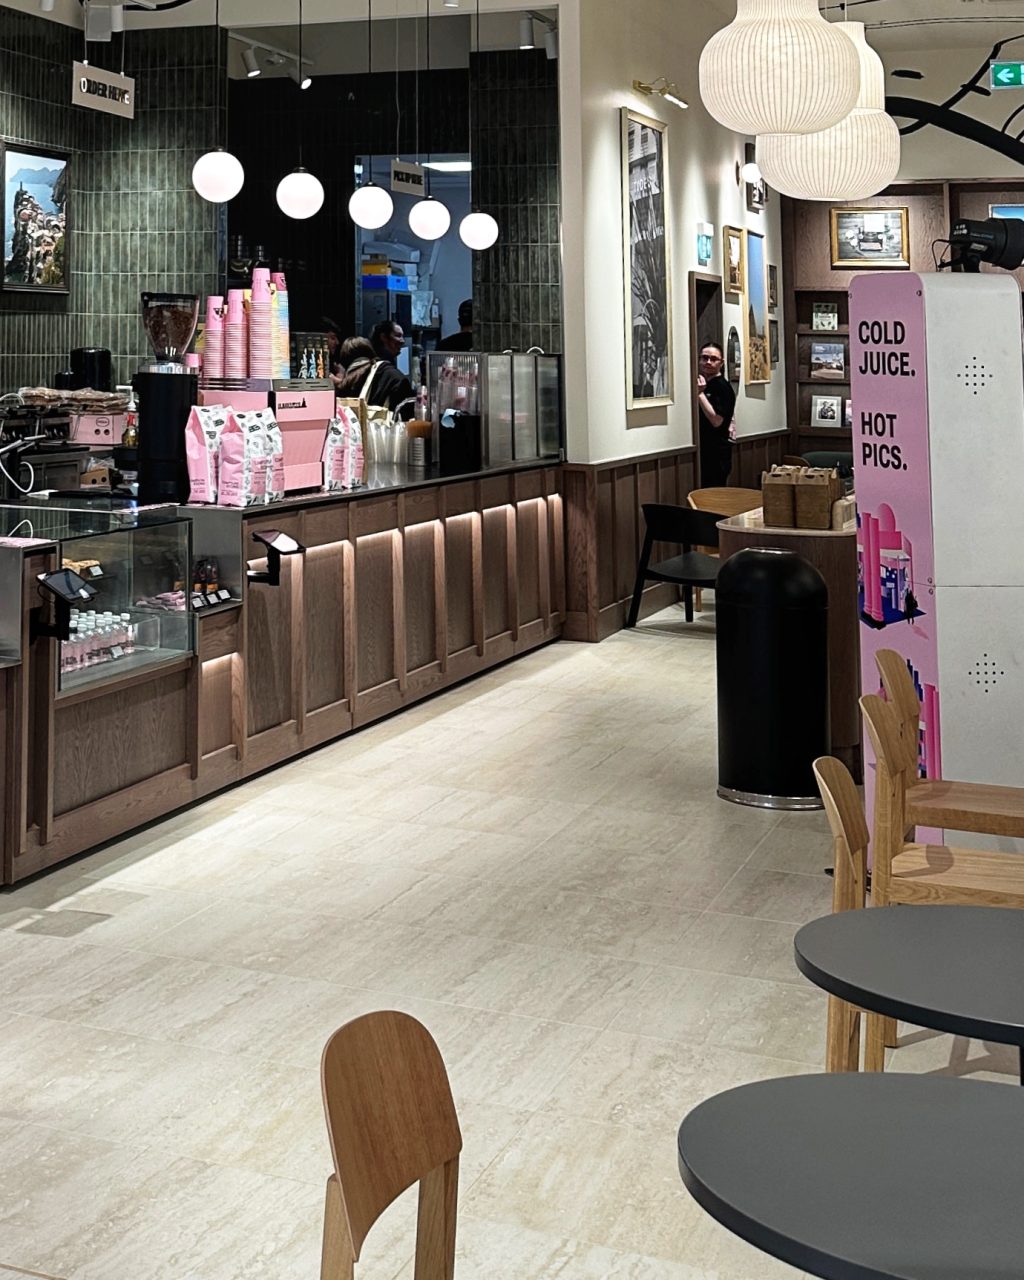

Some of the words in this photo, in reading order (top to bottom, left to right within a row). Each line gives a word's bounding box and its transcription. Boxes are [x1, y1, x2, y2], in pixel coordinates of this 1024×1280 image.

[80, 77, 108, 98] ORDER
[108, 84, 130, 105] HERE
[858, 320, 905, 345] COLD
[859, 351, 916, 377] JUICE.
[861, 412, 897, 438] HOT
[862, 442, 908, 471] PICS.
